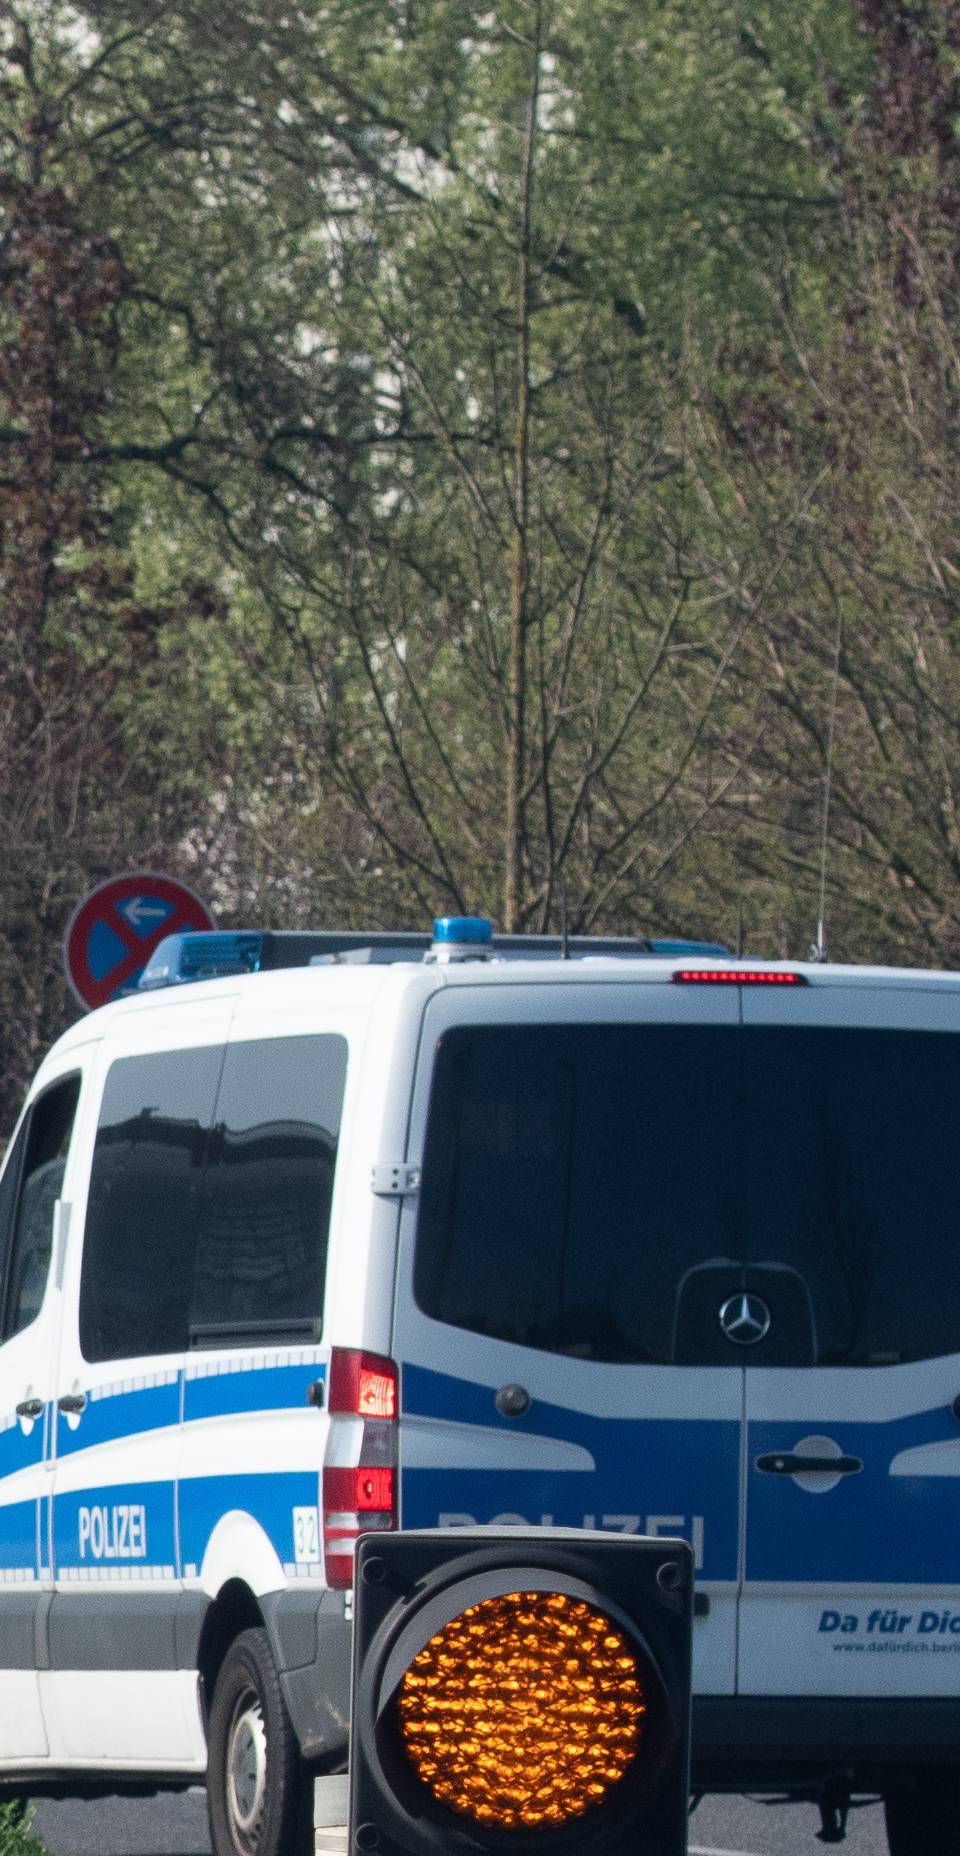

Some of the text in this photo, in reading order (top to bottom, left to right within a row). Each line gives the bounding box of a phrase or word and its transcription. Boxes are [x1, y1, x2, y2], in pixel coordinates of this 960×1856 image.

[78, 1504, 146, 1559] POLIZEI
[818, 1609, 859, 1633] Da
[866, 1609, 912, 1633] für
